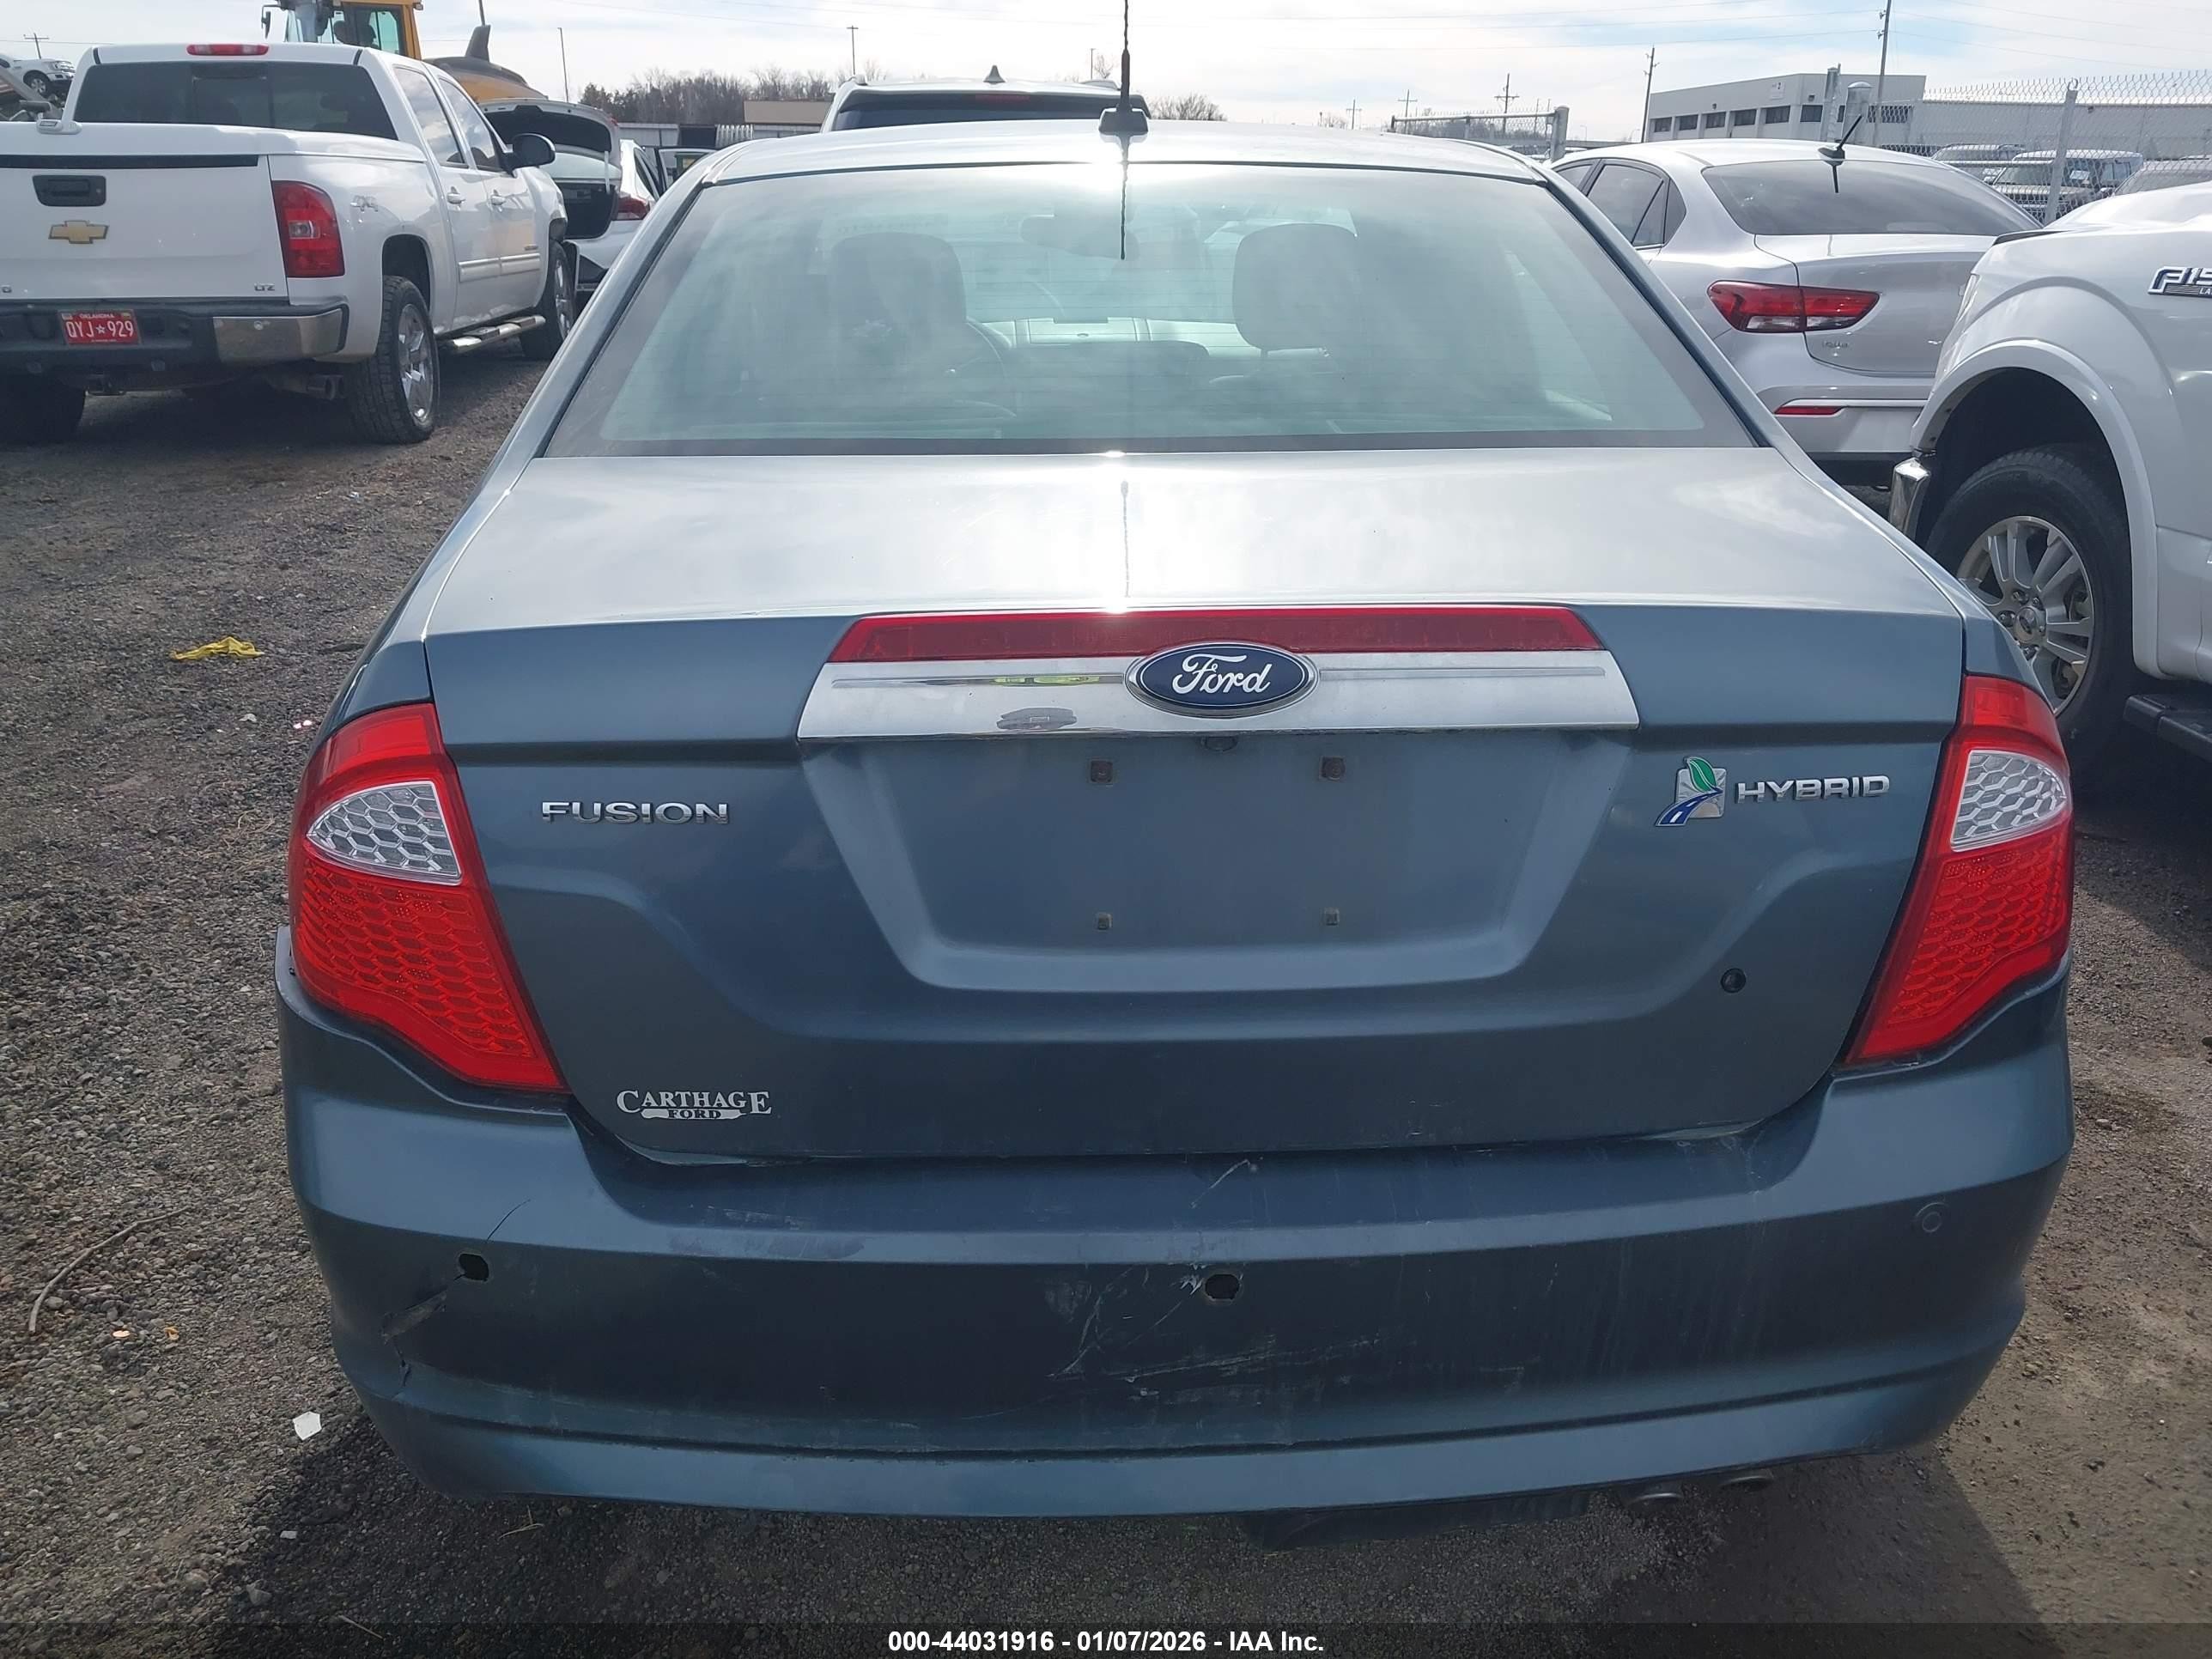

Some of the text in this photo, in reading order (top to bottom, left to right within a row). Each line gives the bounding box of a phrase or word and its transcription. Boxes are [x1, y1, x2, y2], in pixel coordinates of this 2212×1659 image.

[107, 320, 134, 337] 929
[1172, 653, 1273, 694] Ford
[1735, 775, 1890, 804] HYBRID
[542, 801, 729, 824] FUSION
[617, 1090, 772, 1115] CARTHAGE
[667, 1109, 722, 1120] FORD
